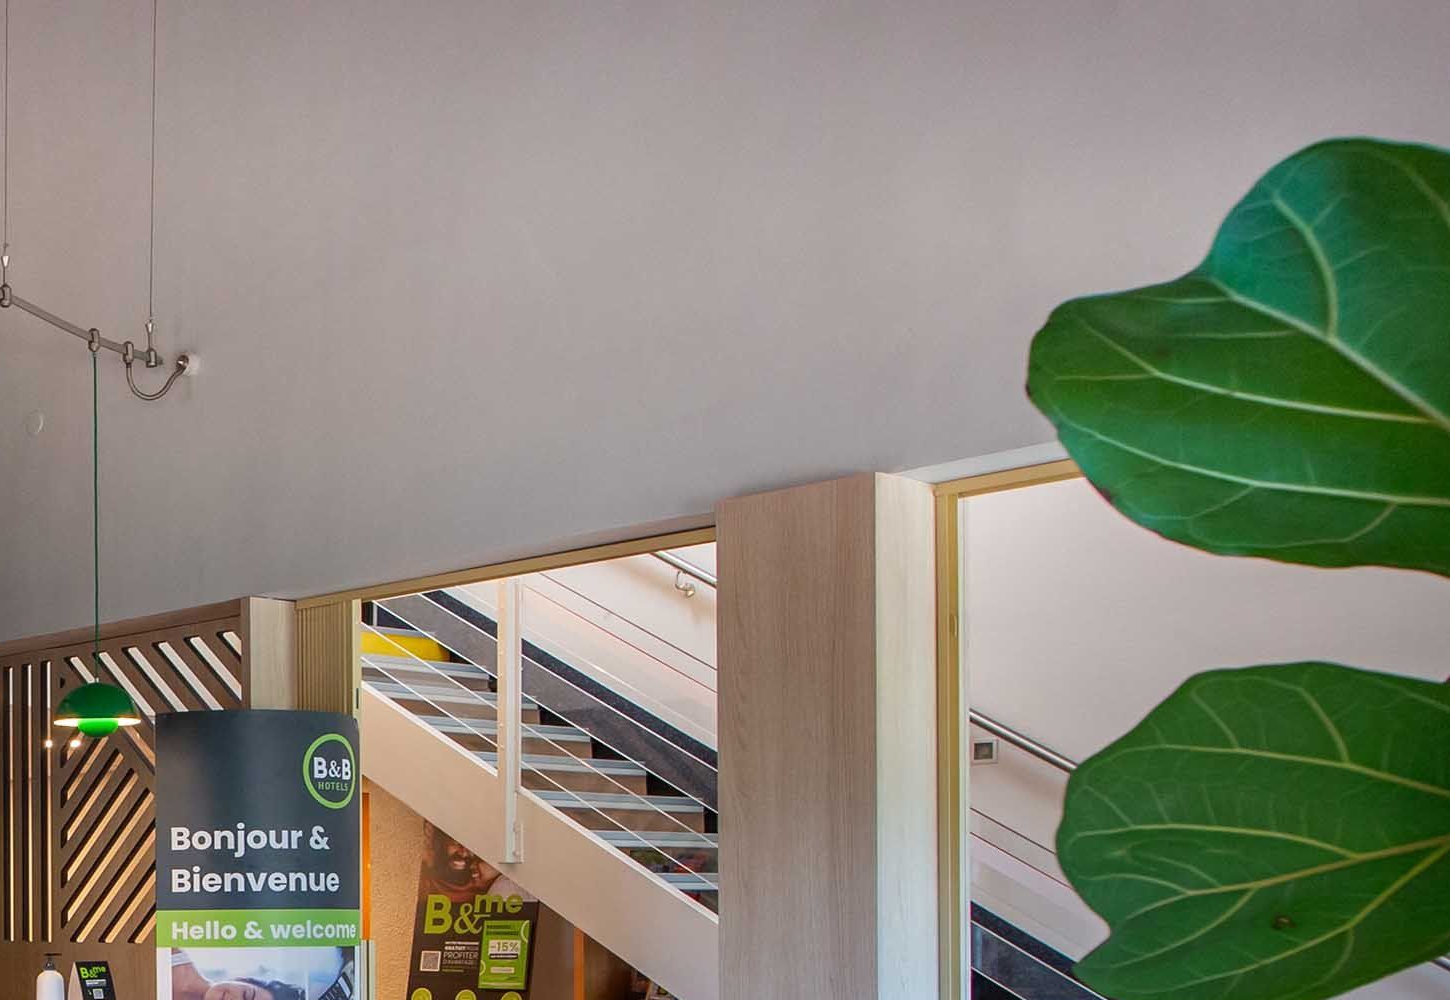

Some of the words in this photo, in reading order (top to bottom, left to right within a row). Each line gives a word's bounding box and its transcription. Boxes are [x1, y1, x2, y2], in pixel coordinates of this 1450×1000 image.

[313, 756, 351, 780] B&B
[318, 781, 348, 792] HOTELS
[170, 822, 303, 858] Bonjour
[309, 825, 331, 850] &
[170, 866, 340, 893] Bienvenue
[423, 894, 524, 935] B&me
[171, 920, 237, 941] Hello
[243, 920, 263, 940] &
[269, 919, 357, 940] welcome
[490, 942, 519, 952] -15%
